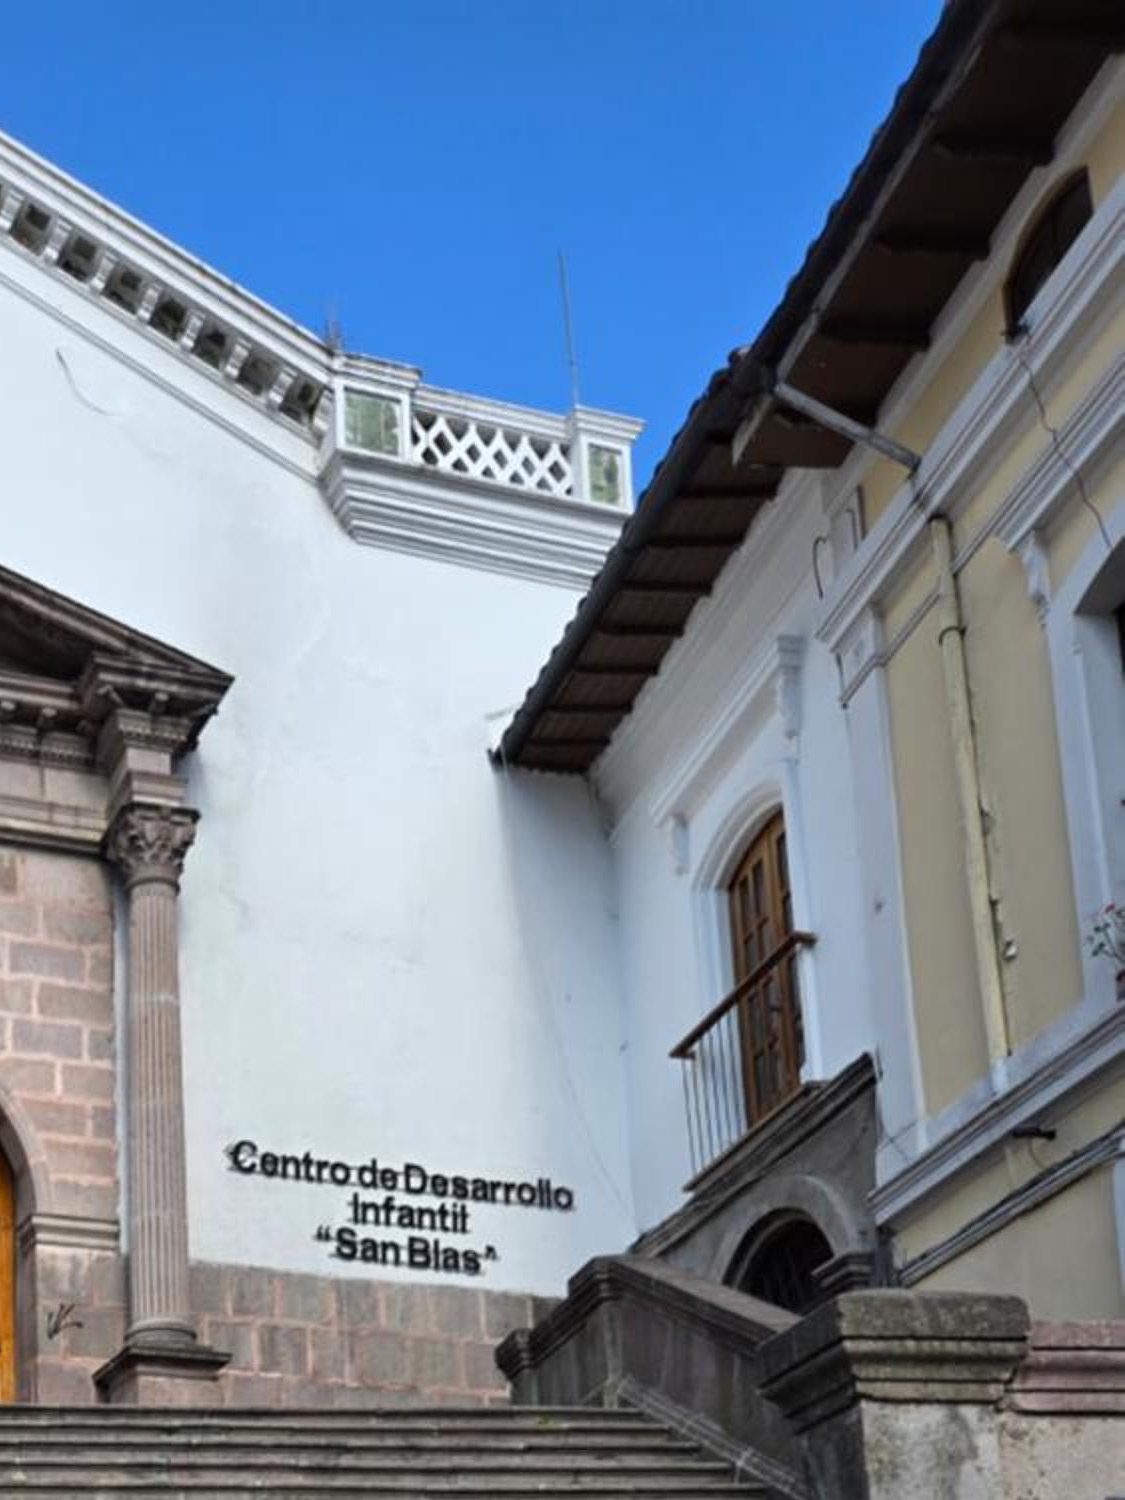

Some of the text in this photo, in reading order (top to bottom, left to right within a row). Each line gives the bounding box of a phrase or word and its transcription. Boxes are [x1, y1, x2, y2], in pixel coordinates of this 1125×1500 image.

[228, 1140, 576, 1211] Centro de Desarrollo
[350, 1192, 470, 1234] Infantil
